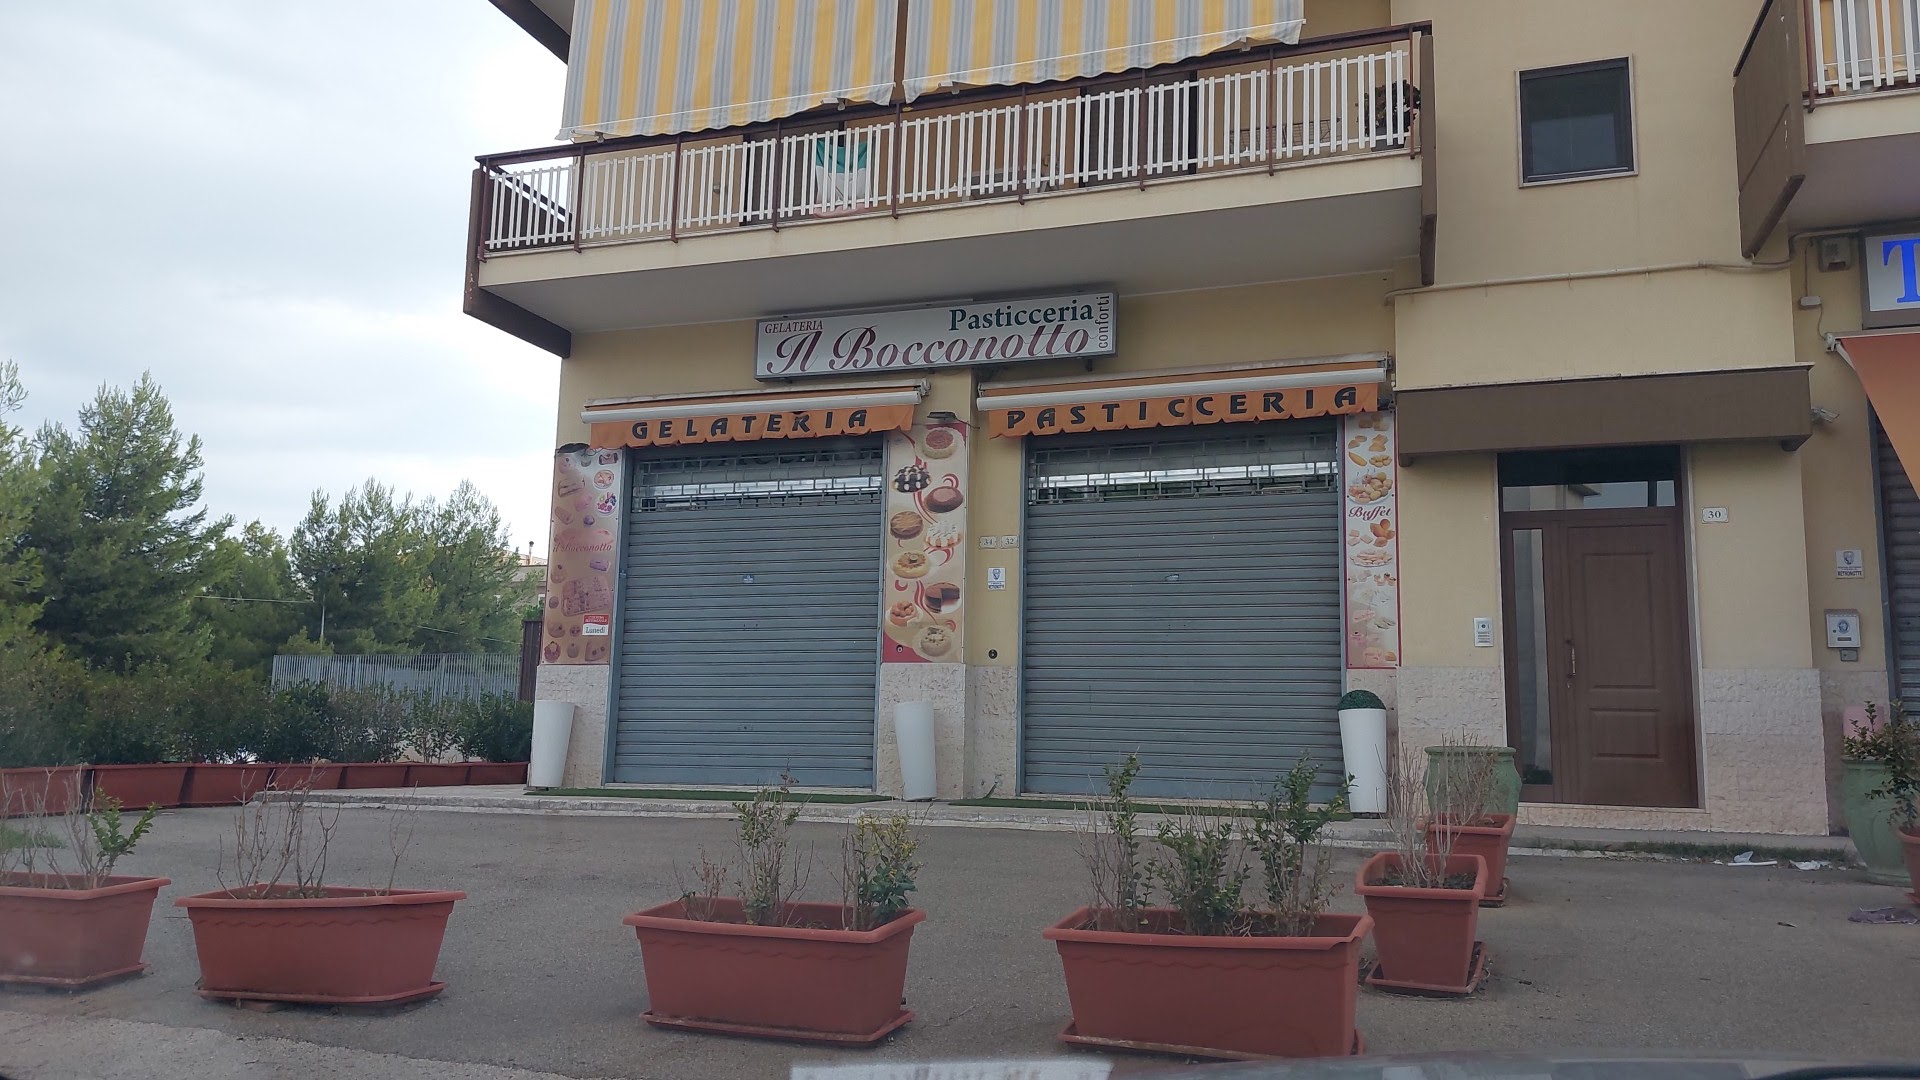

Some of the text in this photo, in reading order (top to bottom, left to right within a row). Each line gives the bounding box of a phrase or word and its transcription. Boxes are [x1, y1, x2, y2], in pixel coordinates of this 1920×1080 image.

[765, 320, 824, 334] GELATERIA
[948, 299, 1094, 331] Pasticceria
[1095, 295, 1110, 349] conforti
[766, 323, 1098, 374] Il Bocconotto
[632, 409, 868, 439] GELATERIA
[1007, 387, 1357, 430] PASTICCERIA
[1348, 505, 1392, 521] Buffet
[1707, 510, 1721, 519] 30
